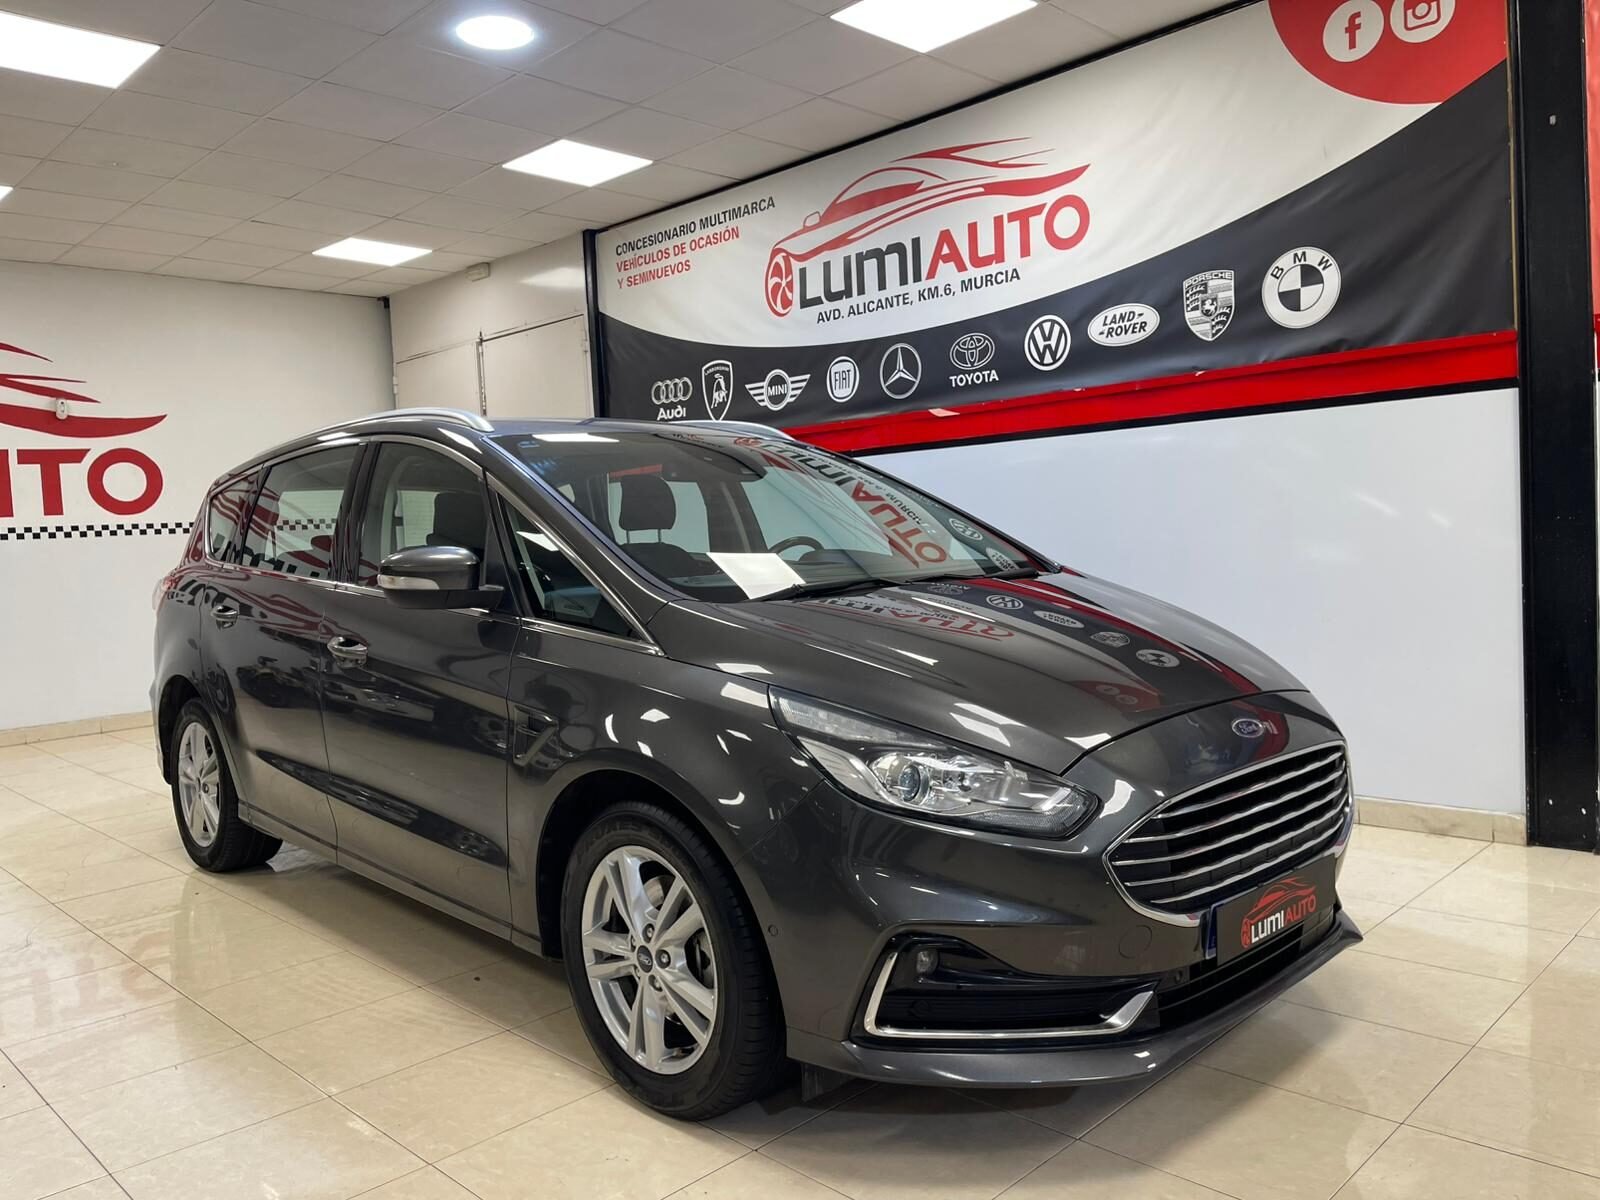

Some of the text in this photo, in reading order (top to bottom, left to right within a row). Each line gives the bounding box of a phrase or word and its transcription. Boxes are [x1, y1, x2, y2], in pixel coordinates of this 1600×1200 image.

[615, 196, 775, 257] CONCESIONARIO MULTIMARCA
[616, 226, 740, 273] VEHÍCULOS DE OCASIÓN
[617, 259, 691, 289] Y SEMINUEVOS
[1271, 251, 1332, 280] BMW
[1185, 272, 1233, 289] PORSCHE
[816, 267, 1021, 324] AVD. ALICANTE, KM.6, MURCIA
[767, 384, 787, 397] MINI
[834, 368, 852, 391] FIAT
[949, 369, 999, 387] TOYOTA
[656, 405, 686, 421] Audi
[0, 447, 164, 518] TO
